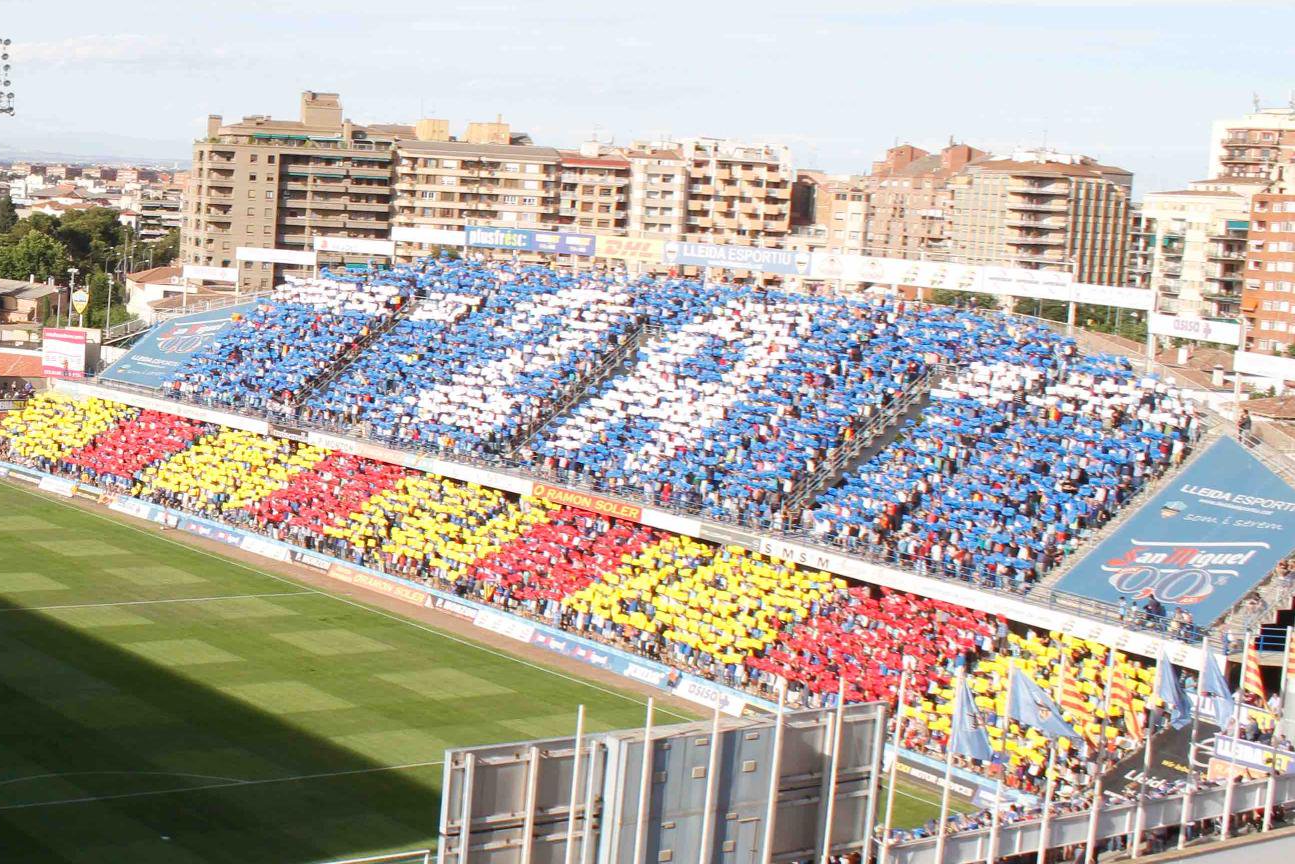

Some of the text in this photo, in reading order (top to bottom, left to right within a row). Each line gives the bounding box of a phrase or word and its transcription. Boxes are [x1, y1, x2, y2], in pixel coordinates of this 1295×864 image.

[606, 239, 654, 257] DHL
[683, 244, 726, 260] LLEIDA
[728, 249, 791, 265] ESPORTIU
[546, 484, 640, 519] RAMON SOLER
[1180, 484, 1232, 501] LLEIDA
[1107, 546, 1256, 568] San Miguel
